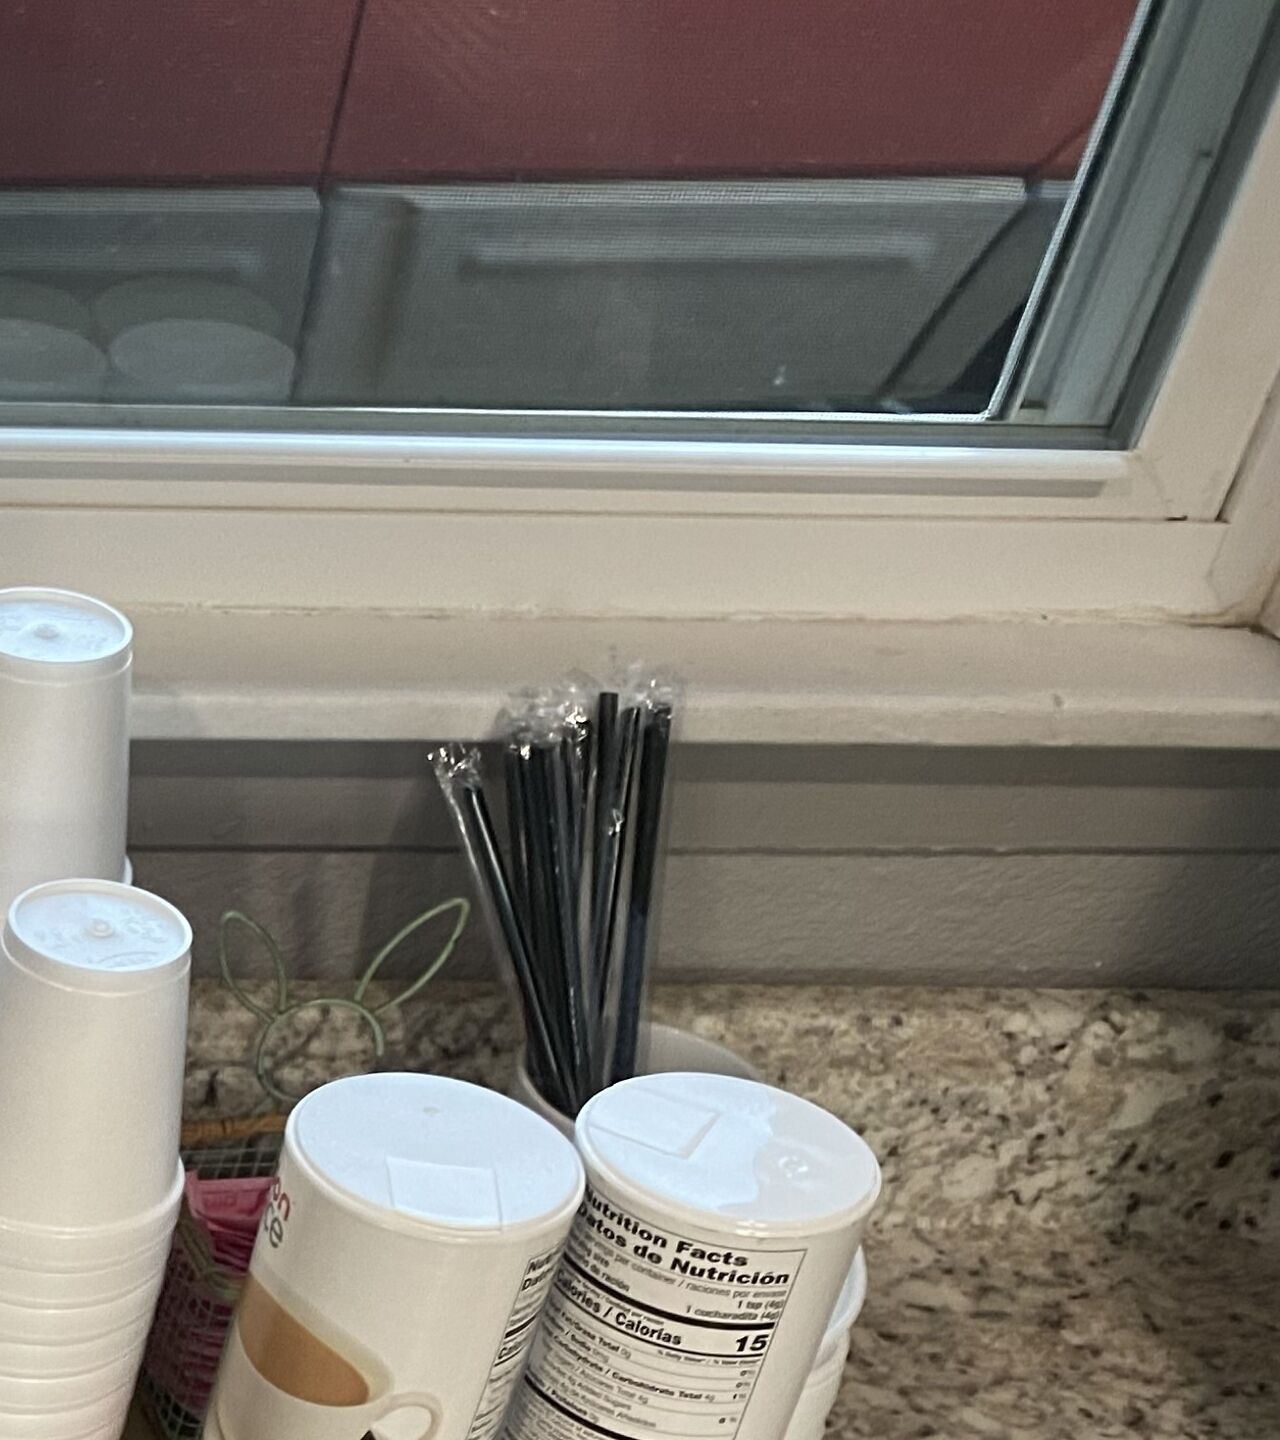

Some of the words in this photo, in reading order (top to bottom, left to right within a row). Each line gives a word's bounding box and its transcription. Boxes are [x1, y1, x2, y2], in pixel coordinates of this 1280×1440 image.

[632, 1244, 663, 1265] de
[670, 1257, 790, 1286] Nutrición
[675, 1240, 749, 1268] Facts
[614, 1310, 683, 1346] Calorías
[735, 1333, 771, 1352] 15
